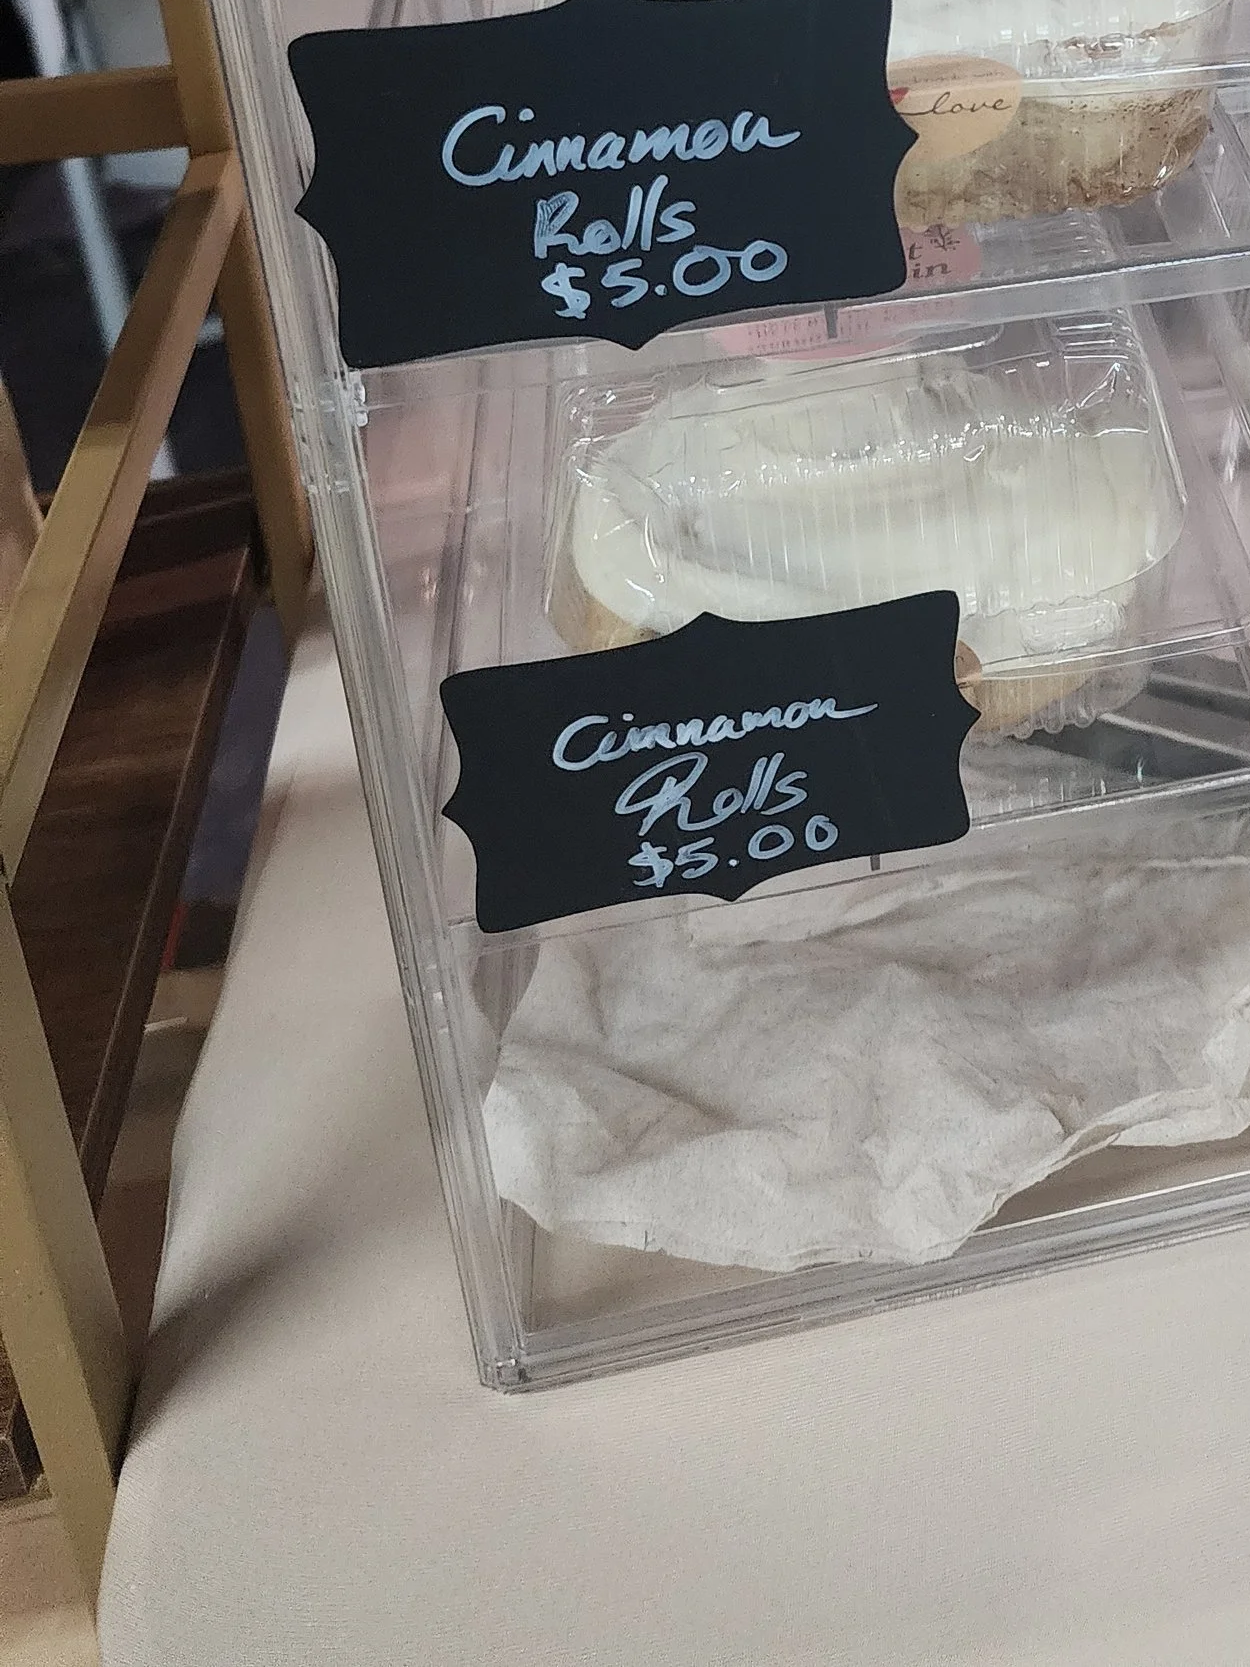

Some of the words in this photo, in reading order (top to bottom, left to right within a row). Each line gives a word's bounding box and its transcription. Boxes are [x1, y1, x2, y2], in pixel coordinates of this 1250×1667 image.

[929, 91, 1012, 116] love
[441, 104, 801, 187] Cinnamon
[533, 175, 697, 259] Rolls
[541, 239, 788, 320] $5.00
[552, 697, 879, 772] Cinnamon
[614, 751, 809, 836] Rolls
[627, 814, 839, 888] $5.00
